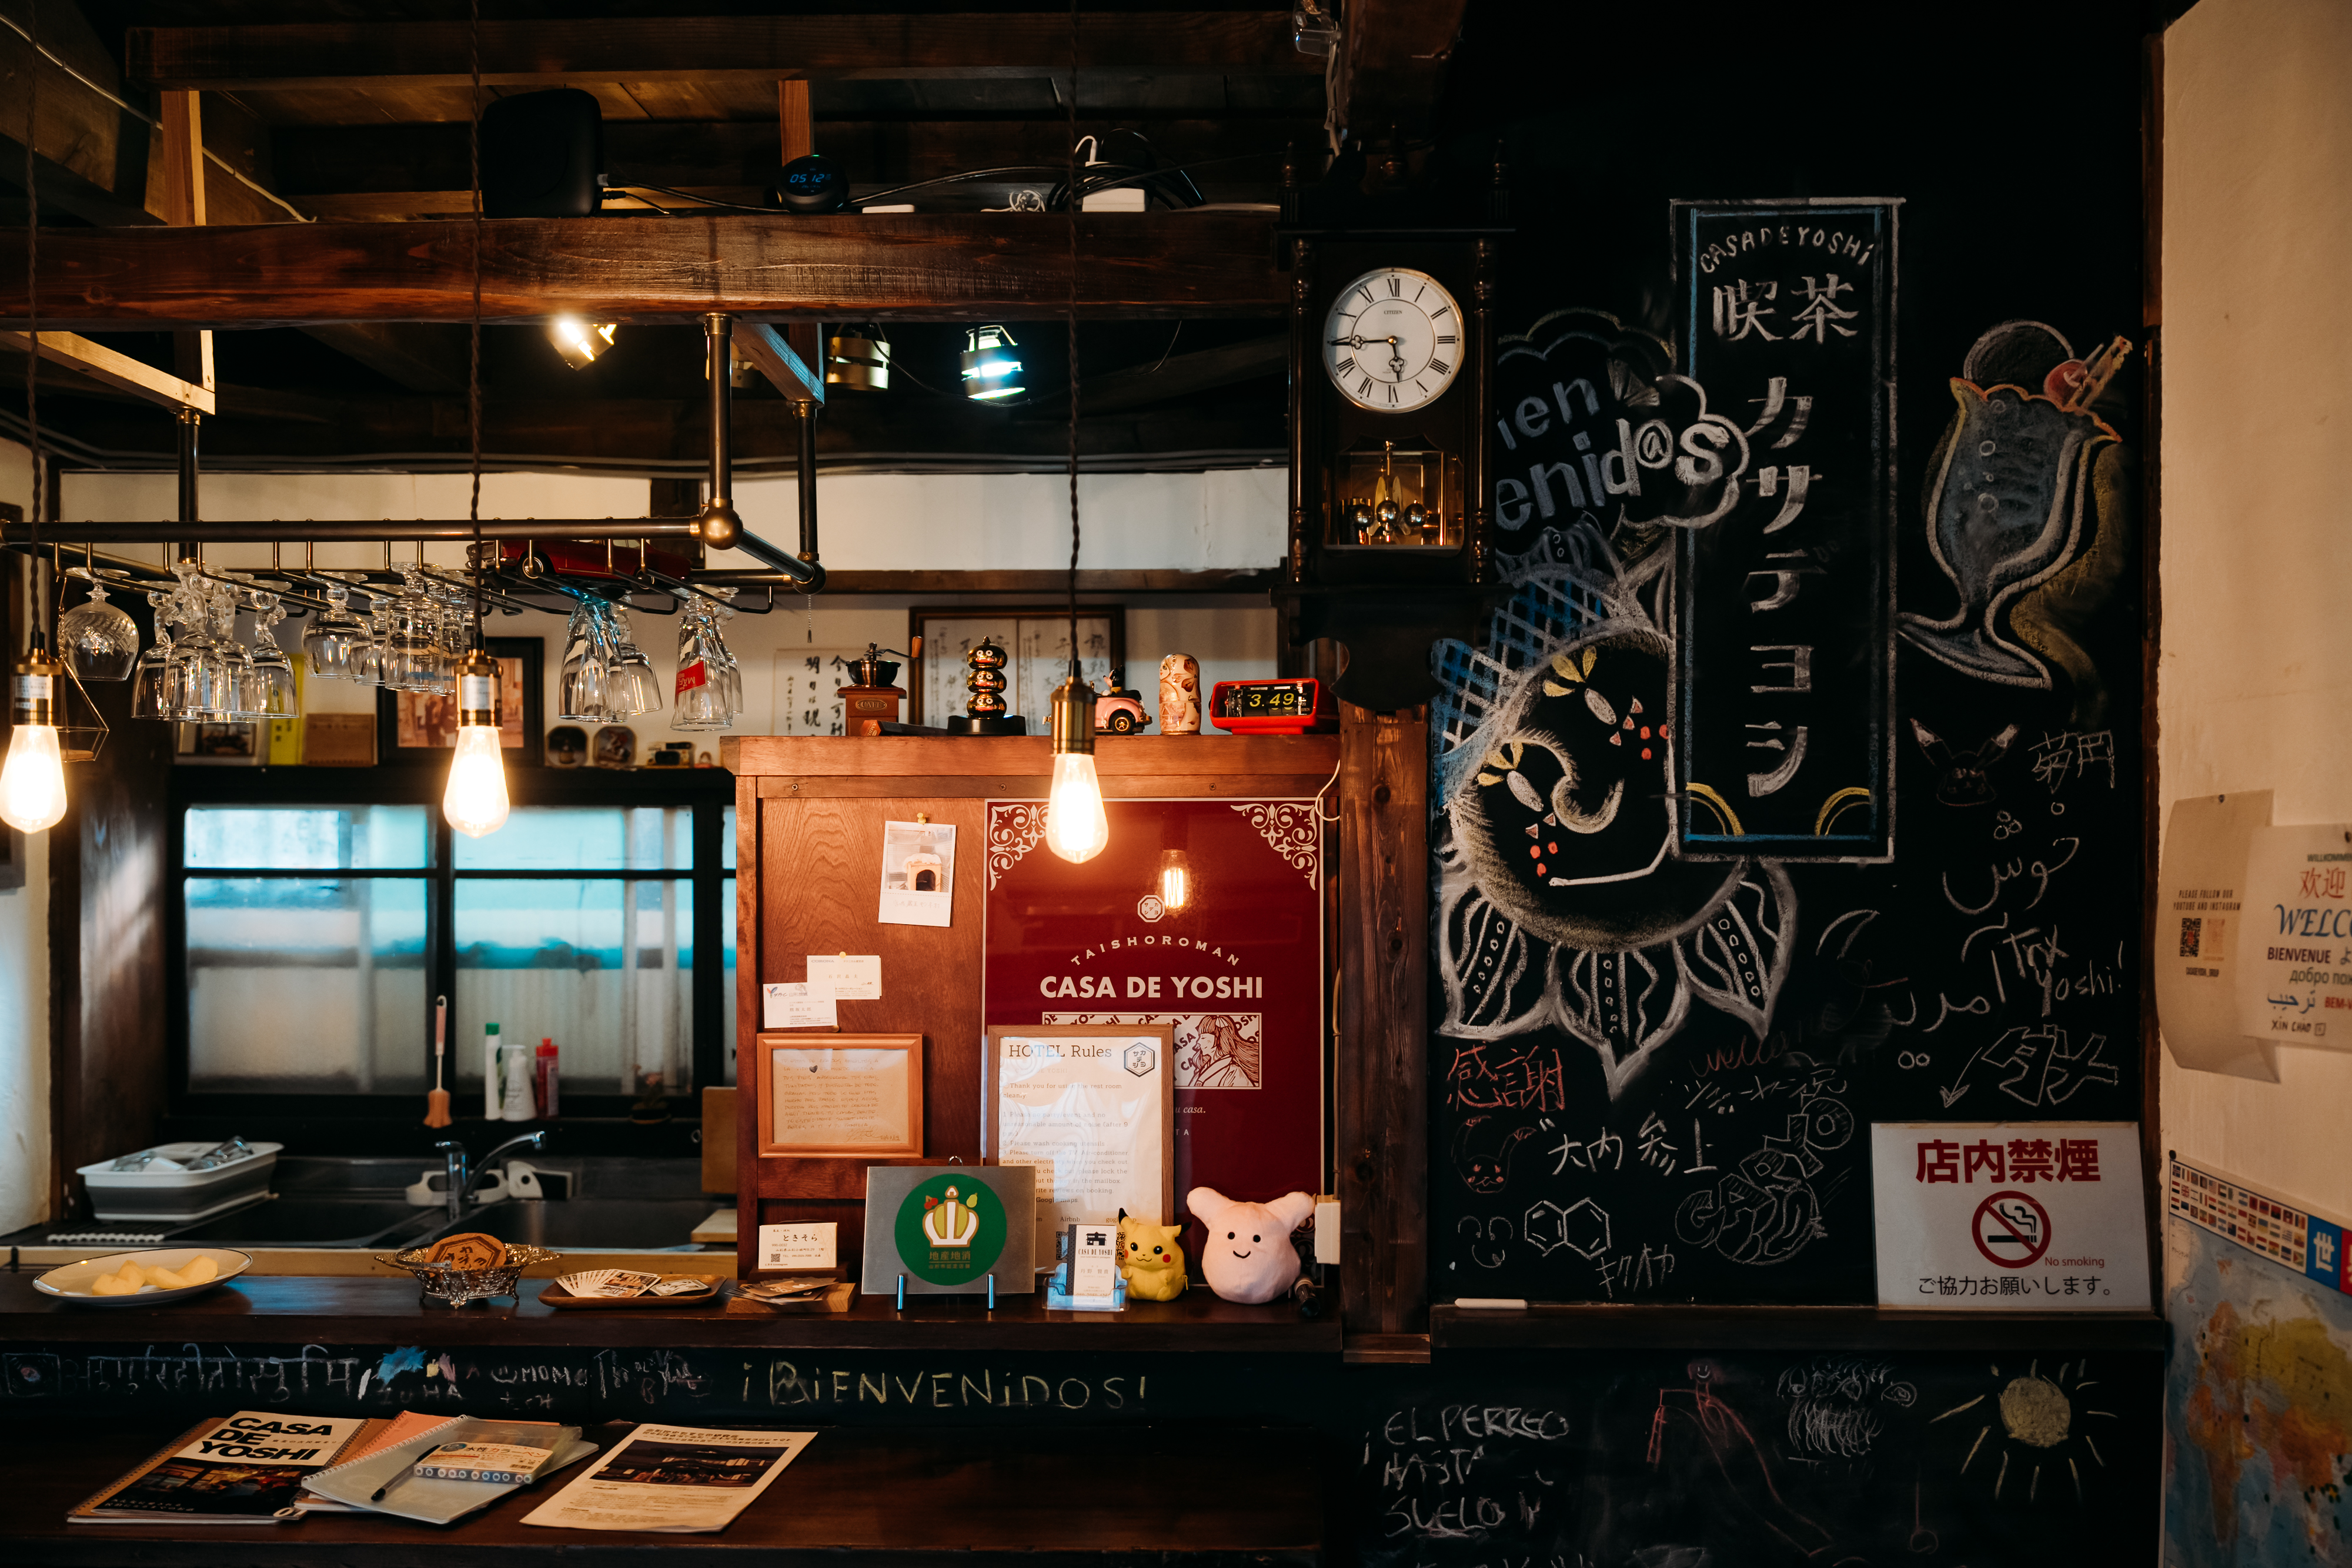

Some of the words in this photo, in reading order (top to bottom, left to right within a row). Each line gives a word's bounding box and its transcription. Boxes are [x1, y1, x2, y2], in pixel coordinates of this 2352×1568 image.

[1712, 273, 1860, 345] 喫茶
[1495, 419, 1730, 531] enid@s
[2298, 867, 2346, 899] 欢迎
[2179, 890, 2198, 898] PLEASE
[2200, 890, 2220, 898] FOLLOW
[2223, 890, 2233, 898] OUR
[2173, 902, 2195, 910] YOUTUBE
[2197, 902, 2207, 910] AND
[2210, 902, 2241, 911] INSTAGRAM
[2274, 904, 2352, 938] WELC
[1071, 935, 1239, 967] TAISHOROMAN
[2267, 947, 2331, 964] BIENVENUE
[1040, 976, 1117, 998] CASA
[1127, 977, 1161, 998] DE
[1171, 976, 1262, 998] YOSHI
[1009, 1045, 1065, 1057] HOTEL
[1071, 1045, 1112, 1057] Rules
[1174, 1032, 1197, 1055] ASA
[1446, 1041, 1565, 1112] 感謝
[1183, 1106, 1206, 1115] casa.
[1916, 1139, 2101, 1183] 店内禁煙
[930, 1251, 970, 1260] 地産地消
[2045, 1257, 2059, 1266] No
[2062, 1256, 2104, 1268] smoking
[1919, 1276, 2110, 1296] ご協力お願いします。
[229, 1417, 332, 1435] CASA
[208, 1429, 272, 1445] DE
[198, 1441, 322, 1460] YOSHI
